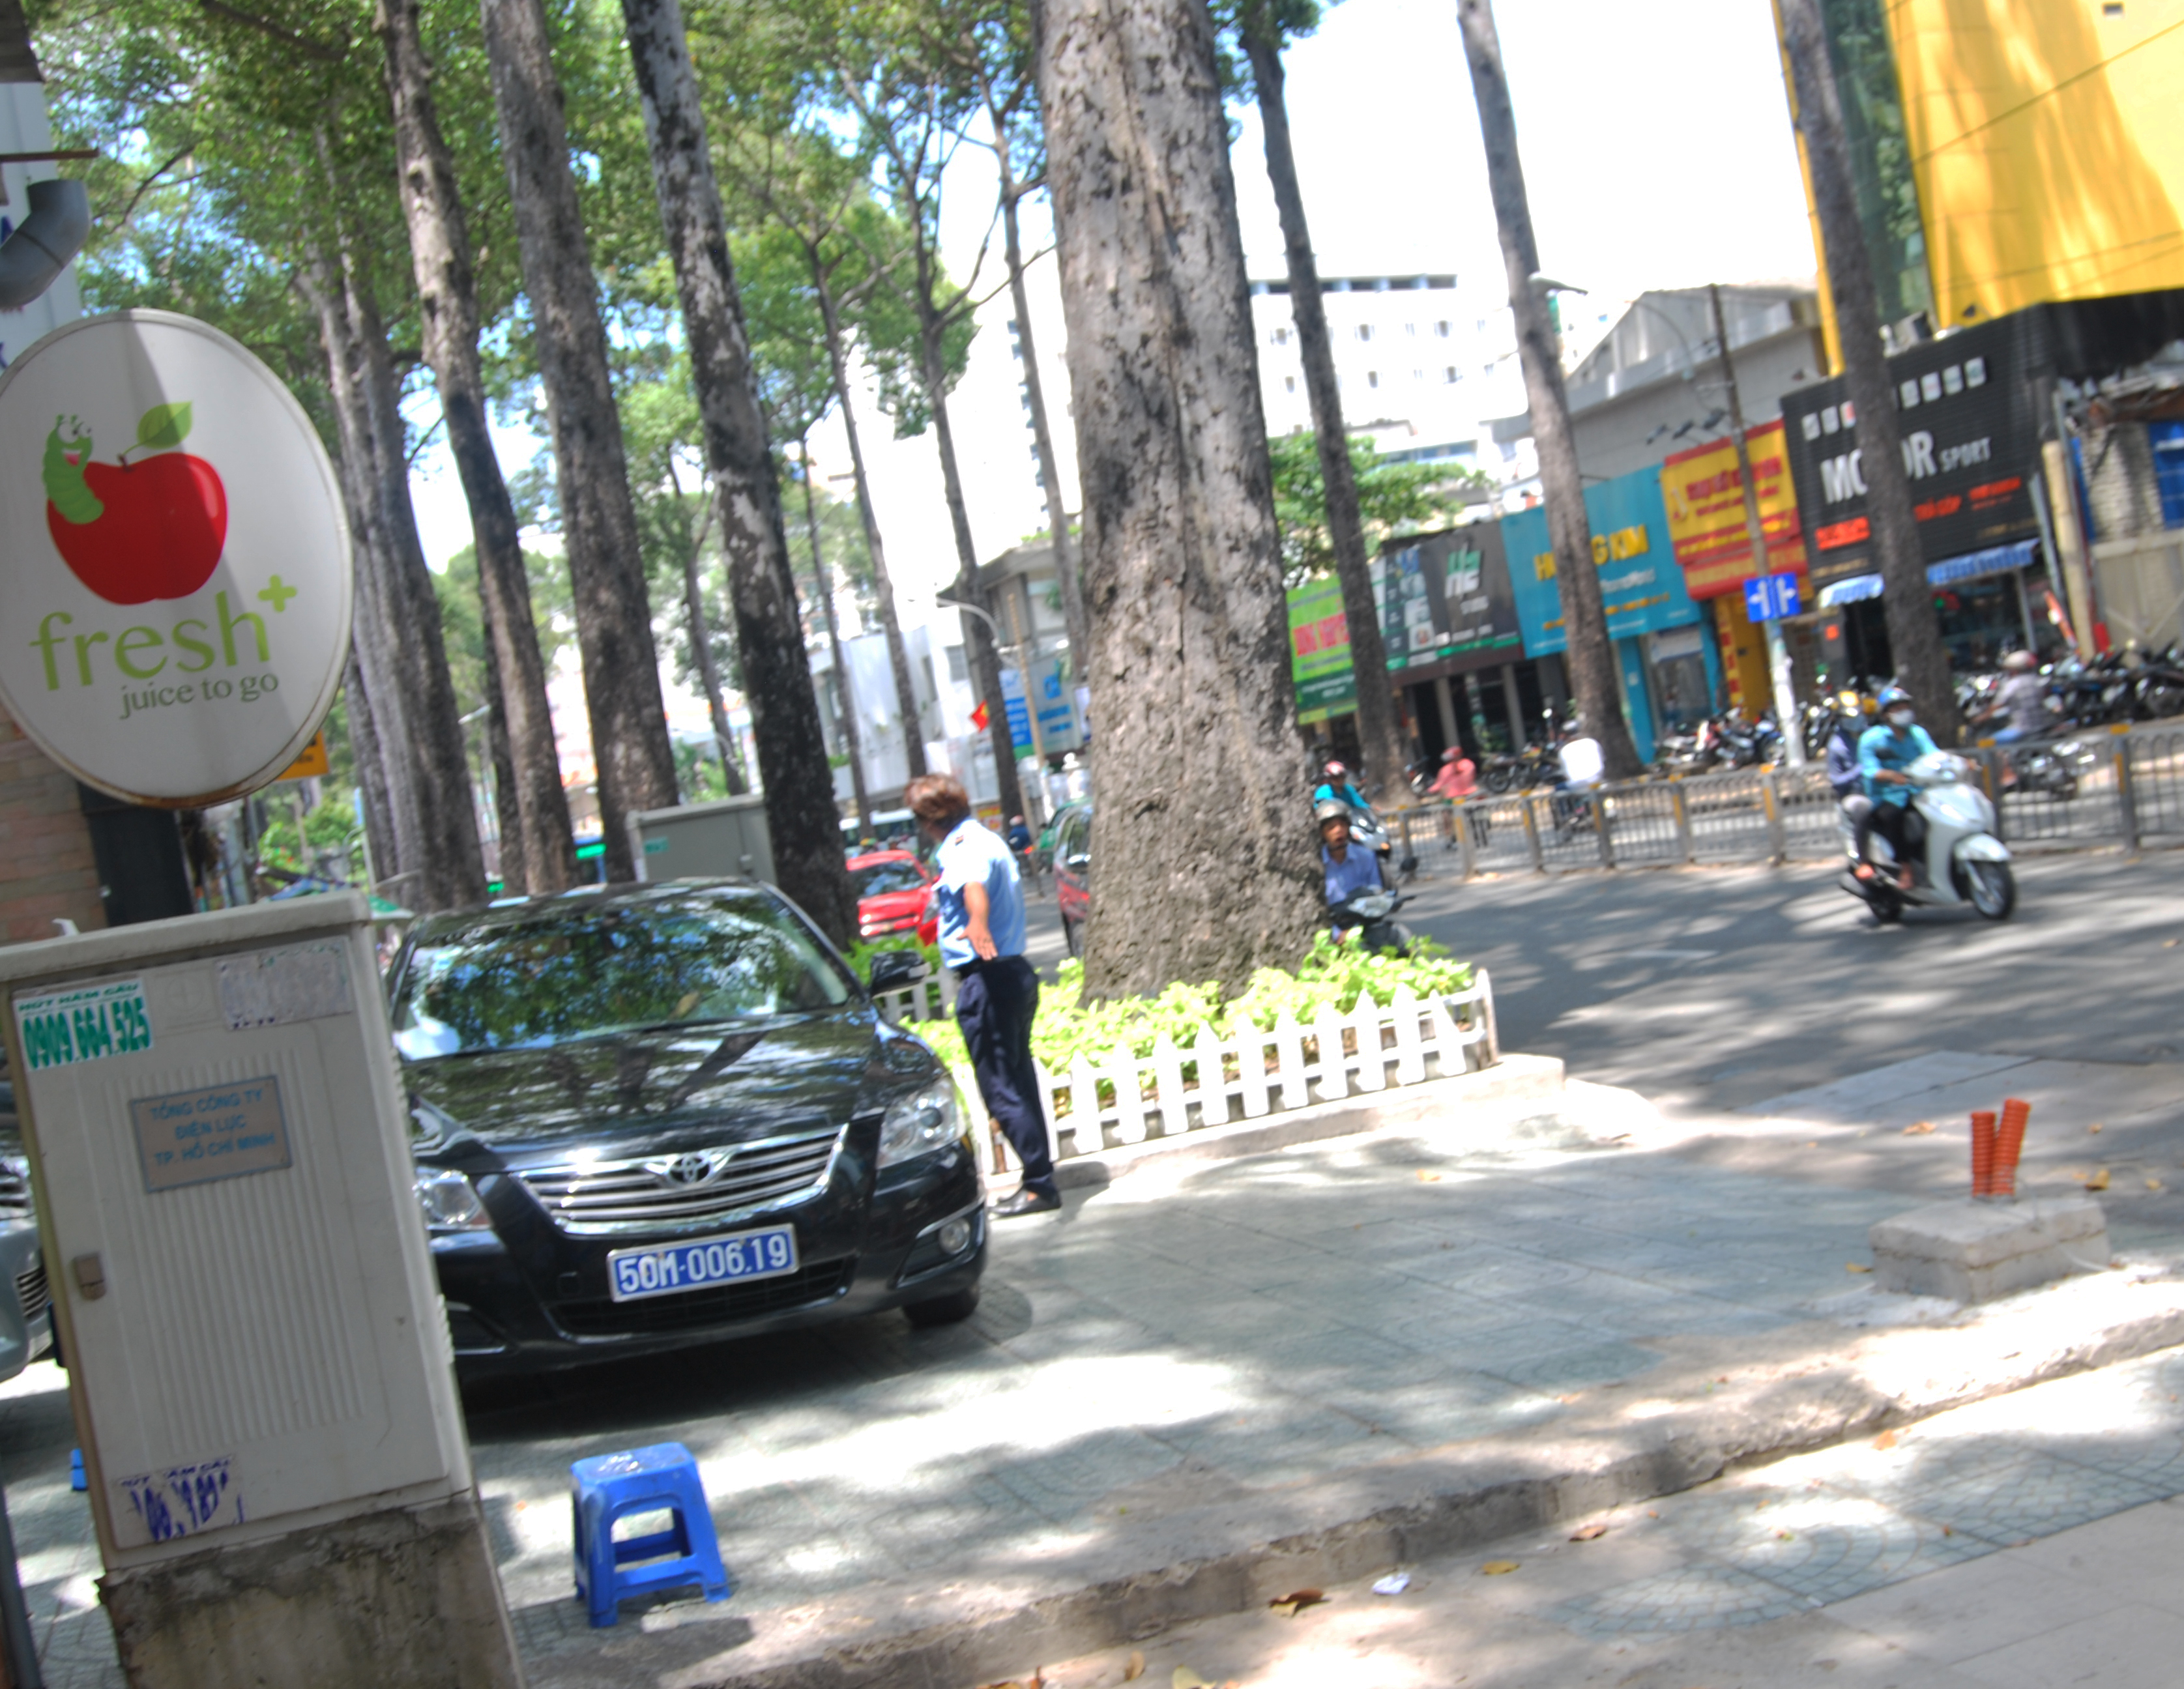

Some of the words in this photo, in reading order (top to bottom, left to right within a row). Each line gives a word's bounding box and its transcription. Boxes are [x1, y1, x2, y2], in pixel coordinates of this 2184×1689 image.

[1939, 436, 1992, 473] SPORT
[120, 681, 195, 719] juice
[201, 678, 233, 701] to
[239, 672, 279, 702] go
[196, 1093, 241, 1112] CÔNG
[243, 1088, 263, 1104] TY
[237, 1131, 276, 1151] MINH
[618, 1235, 789, 1293] 50M-006.19
